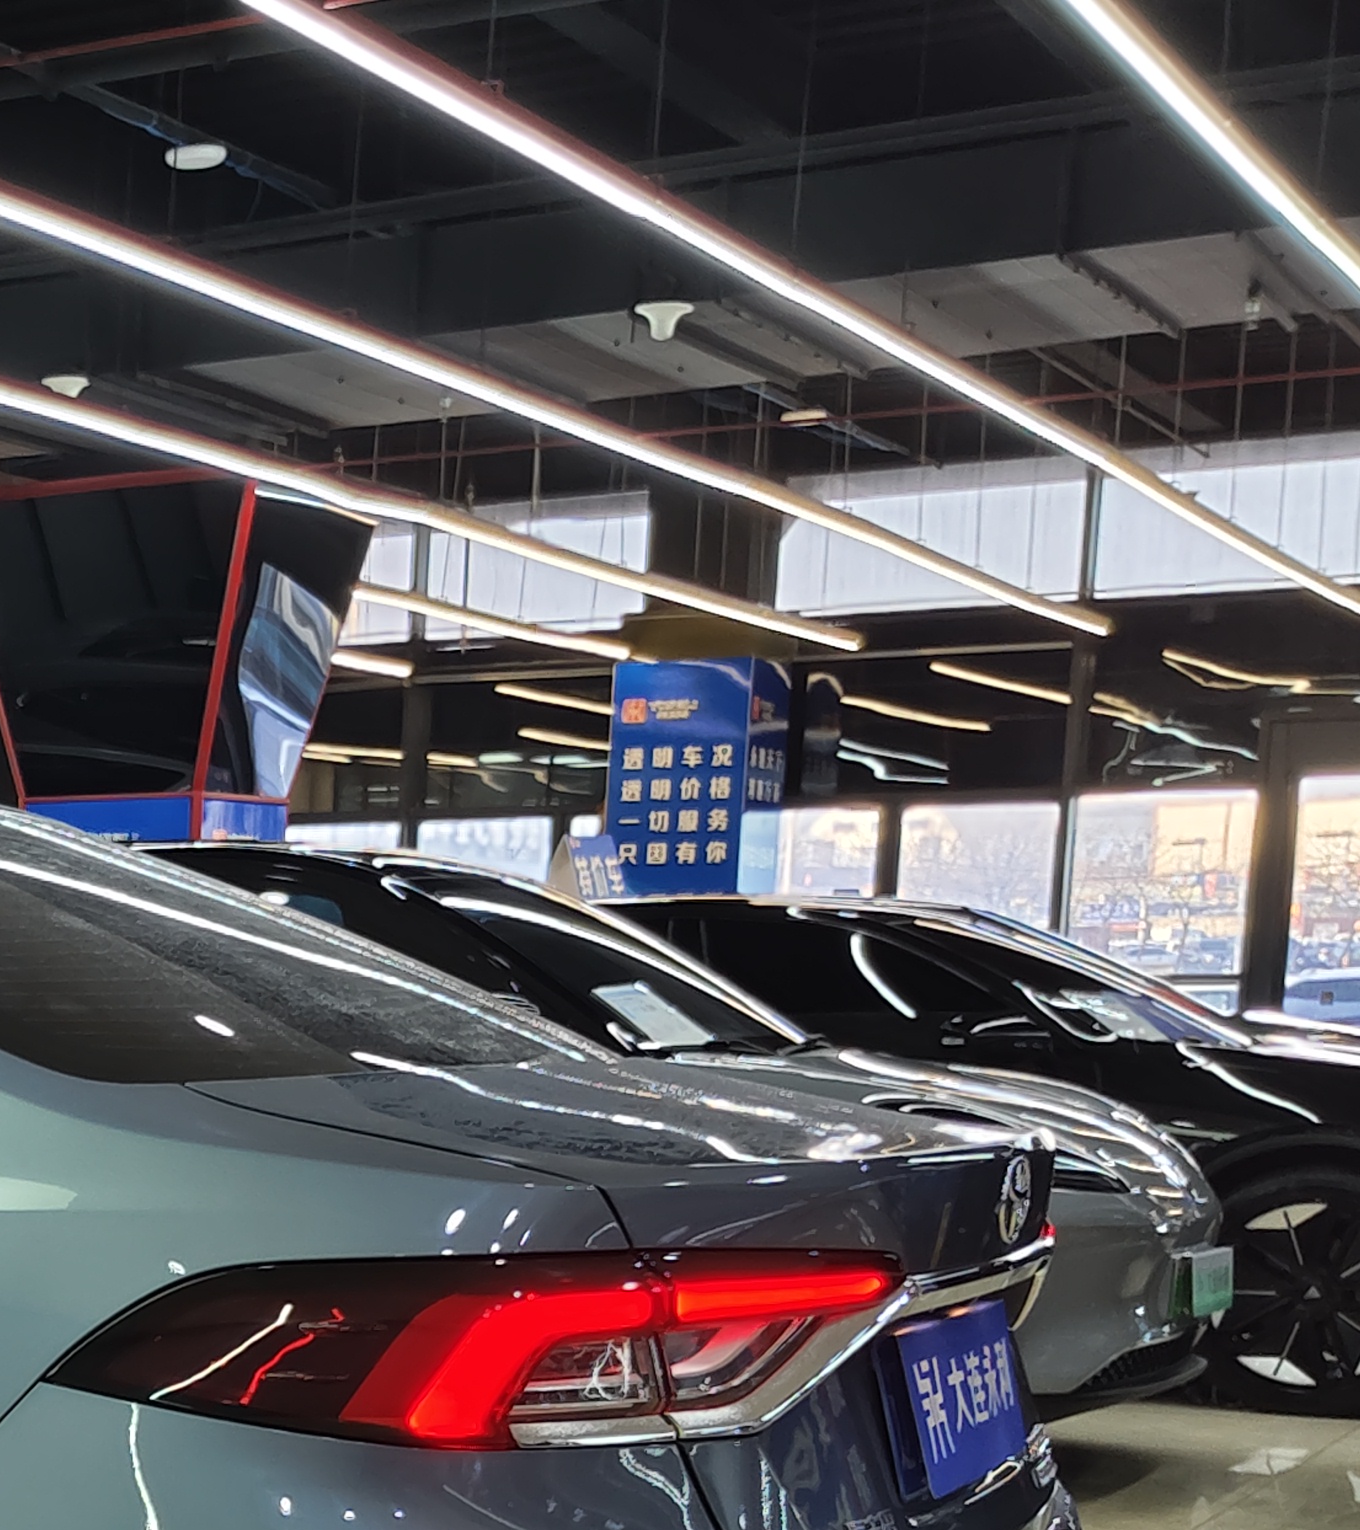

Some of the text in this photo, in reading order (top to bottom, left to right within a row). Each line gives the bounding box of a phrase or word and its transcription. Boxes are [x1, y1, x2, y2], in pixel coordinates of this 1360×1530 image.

[622, 744, 733, 770] 透明车况
[620, 776, 731, 802] 透明价格
[618, 808, 729, 833] 一切服务
[617, 841, 727, 866] 只因有你
